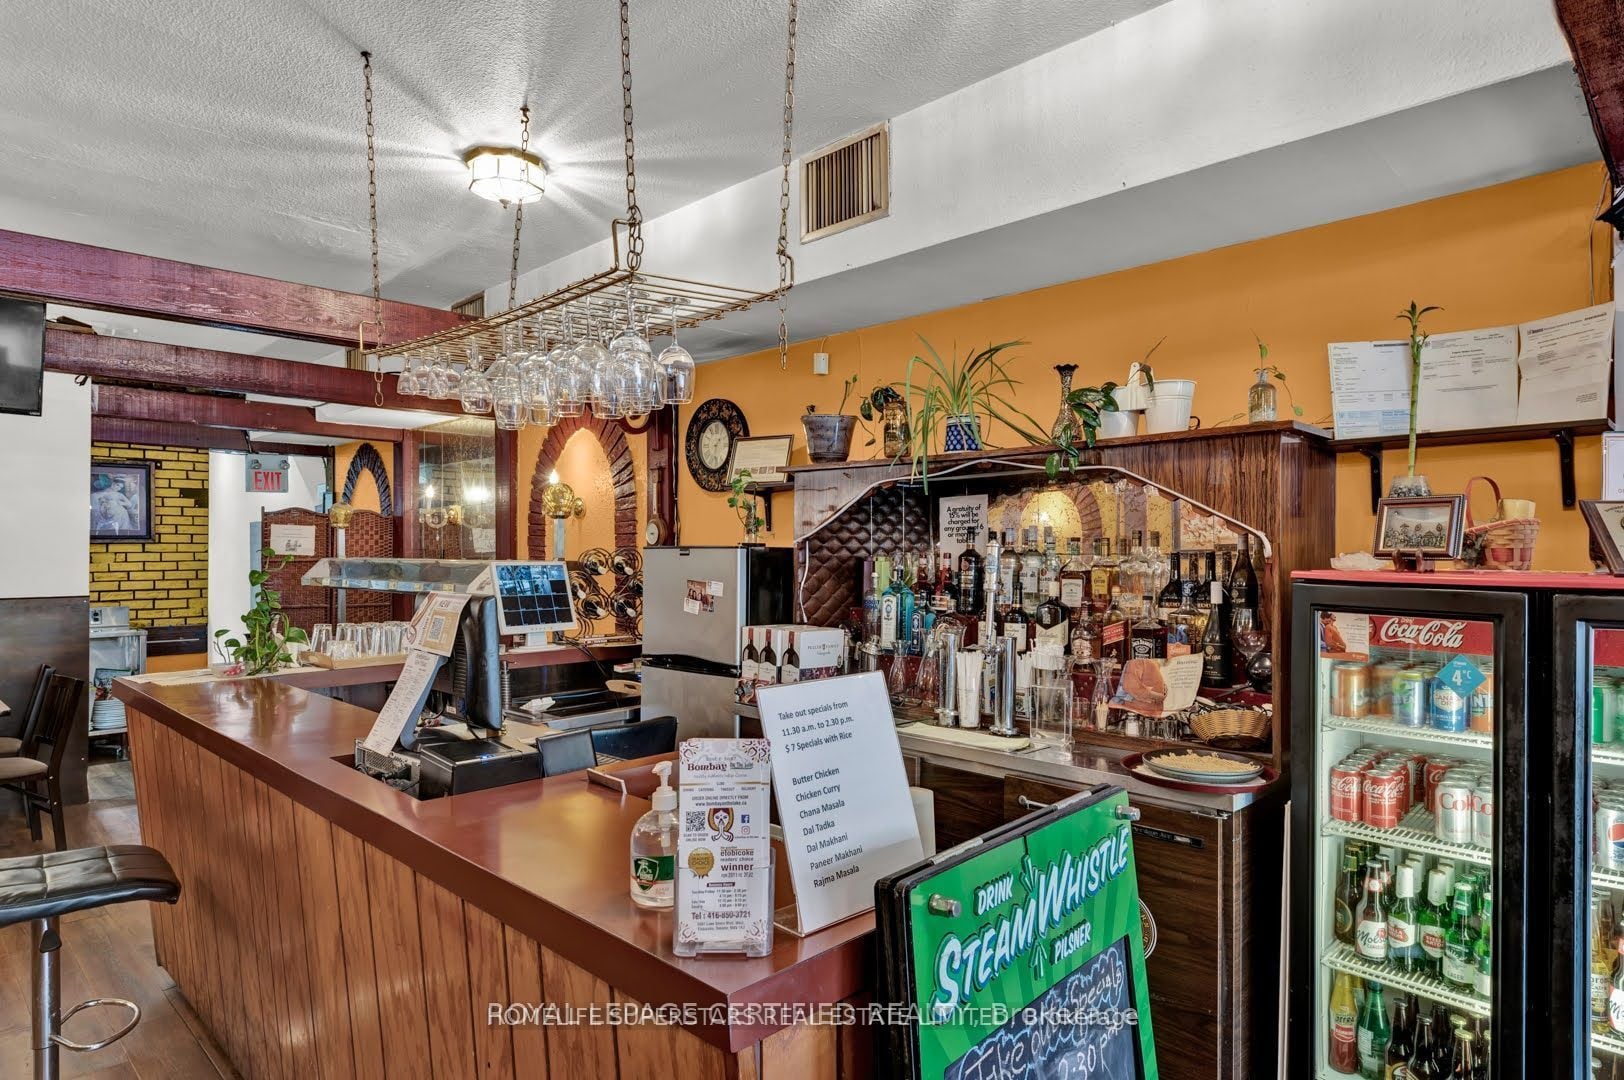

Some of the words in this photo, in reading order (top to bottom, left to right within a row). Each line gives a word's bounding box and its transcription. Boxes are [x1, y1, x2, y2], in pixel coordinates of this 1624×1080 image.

[253, 470, 282, 491] EXIT
[952, 504, 974, 514] gratuity
[1380, 617, 1467, 649] Coca-Cola
[778, 712, 794, 720] Take
[808, 704, 832, 716] specials
[833, 701, 848, 709] from
[782, 726, 800, 736] 11.30
[802, 724, 816, 733] a.m.
[826, 718, 839, 727] 2.30
[840, 716, 854, 725] p.m.
[785, 744, 790, 754] $
[796, 738, 823, 751] Specials
[824, 735, 839, 744] with
[839, 731, 853, 741] Rice
[687, 763, 727, 771] Bombay
[792, 775, 813, 786] Butter
[814, 767, 840, 780] Chicken
[795, 790, 821, 802] Chicken
[822, 784, 841, 794] Curry
[799, 808, 820, 819] Chana
[821, 800, 846, 812] Masala
[802, 826, 815, 836] Dal
[816, 820, 835, 832] Tadka
[806, 843, 818, 854] Dal
[819, 832, 849, 849] Makhani
[720, 863, 754, 871] winner
[810, 858, 834, 871] Paneer
[834, 845, 863, 862] Makhani
[813, 875, 835, 888] Rajma
[836, 865, 860, 878] Masala
[976, 875, 1013, 915] DRINK
[934, 898, 1037, 1022] STEAM
[1037, 825, 1129, 938] WHISTLE
[1052, 920, 1091, 964] PILSNER
[1070, 957, 1122, 1010] Specials
